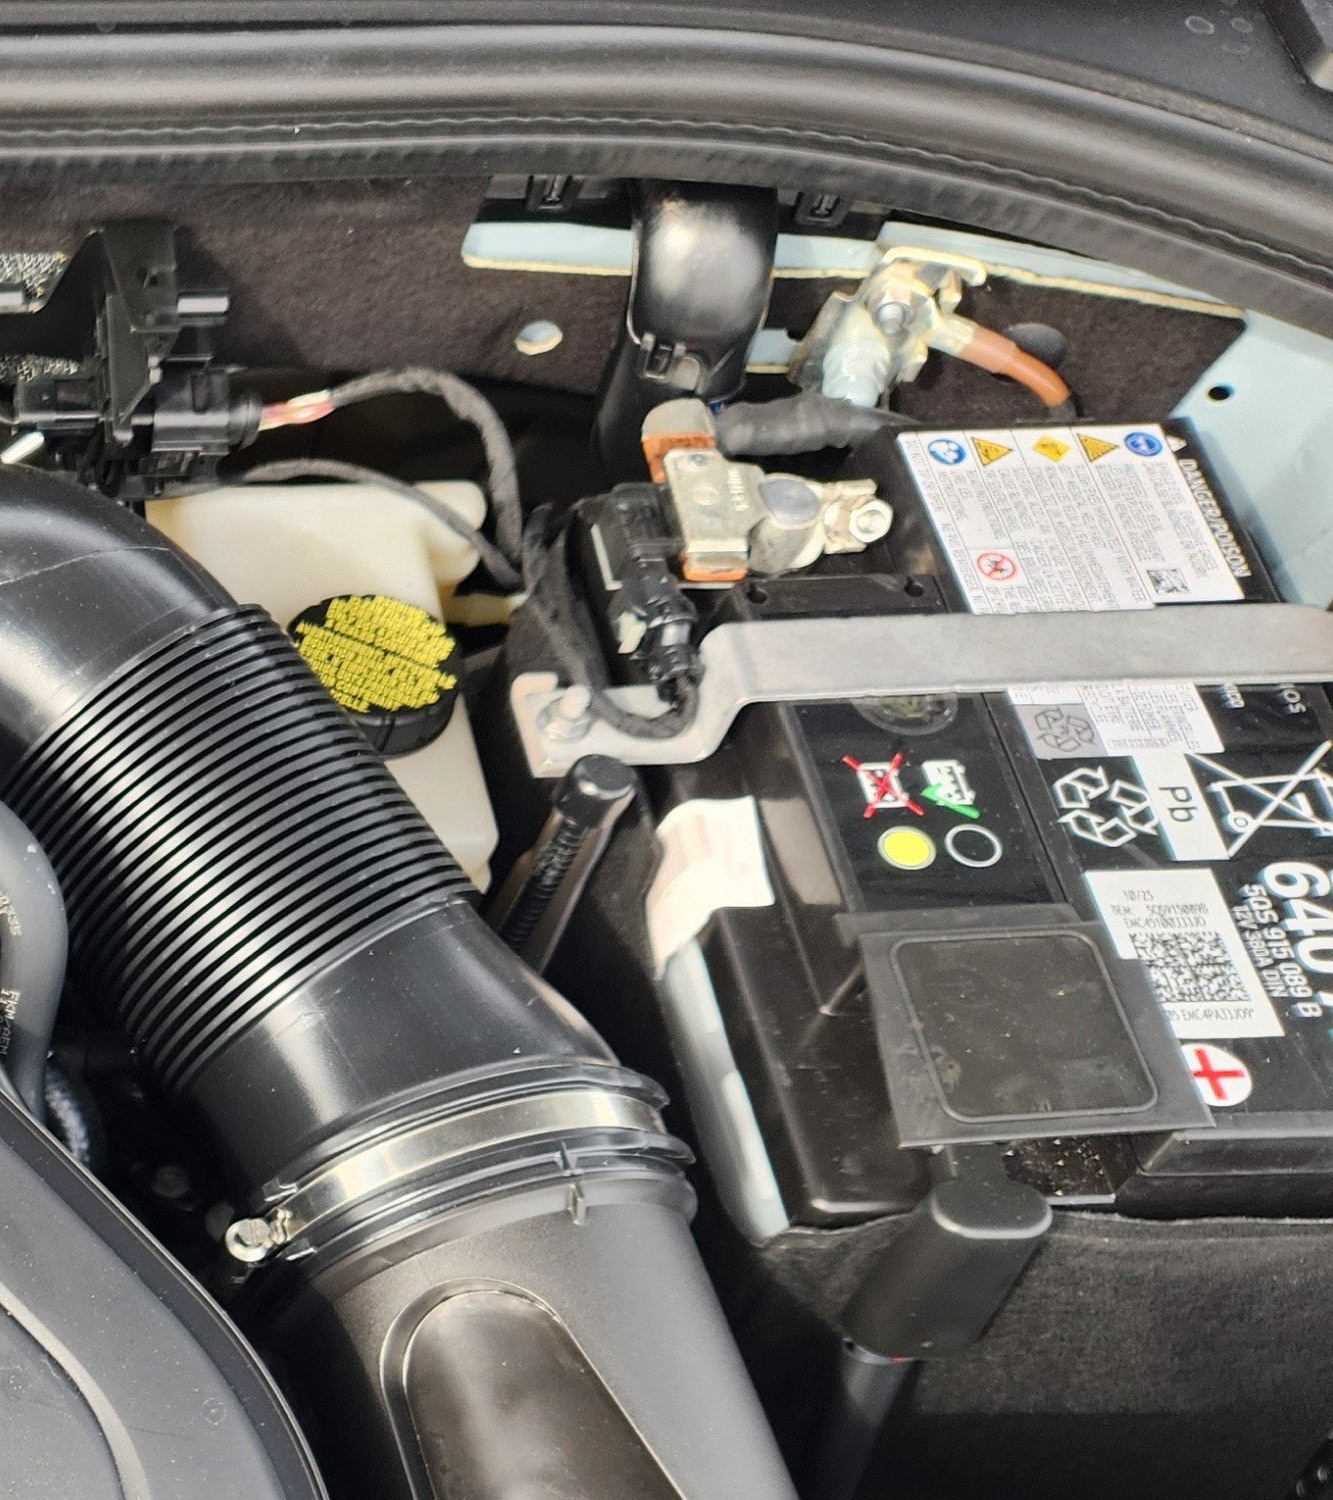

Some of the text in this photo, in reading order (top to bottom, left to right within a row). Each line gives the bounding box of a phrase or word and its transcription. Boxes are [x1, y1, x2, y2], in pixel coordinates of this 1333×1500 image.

[1177, 458, 1252, 579] DANGER/POISON
[1159, 786, 1197, 822] Pb
[1243, 883, 1281, 925] 5QS
[1262, 927, 1295, 960] 915
[1281, 963, 1313, 997] 089
[1263, 970, 1288, 997] DIN
